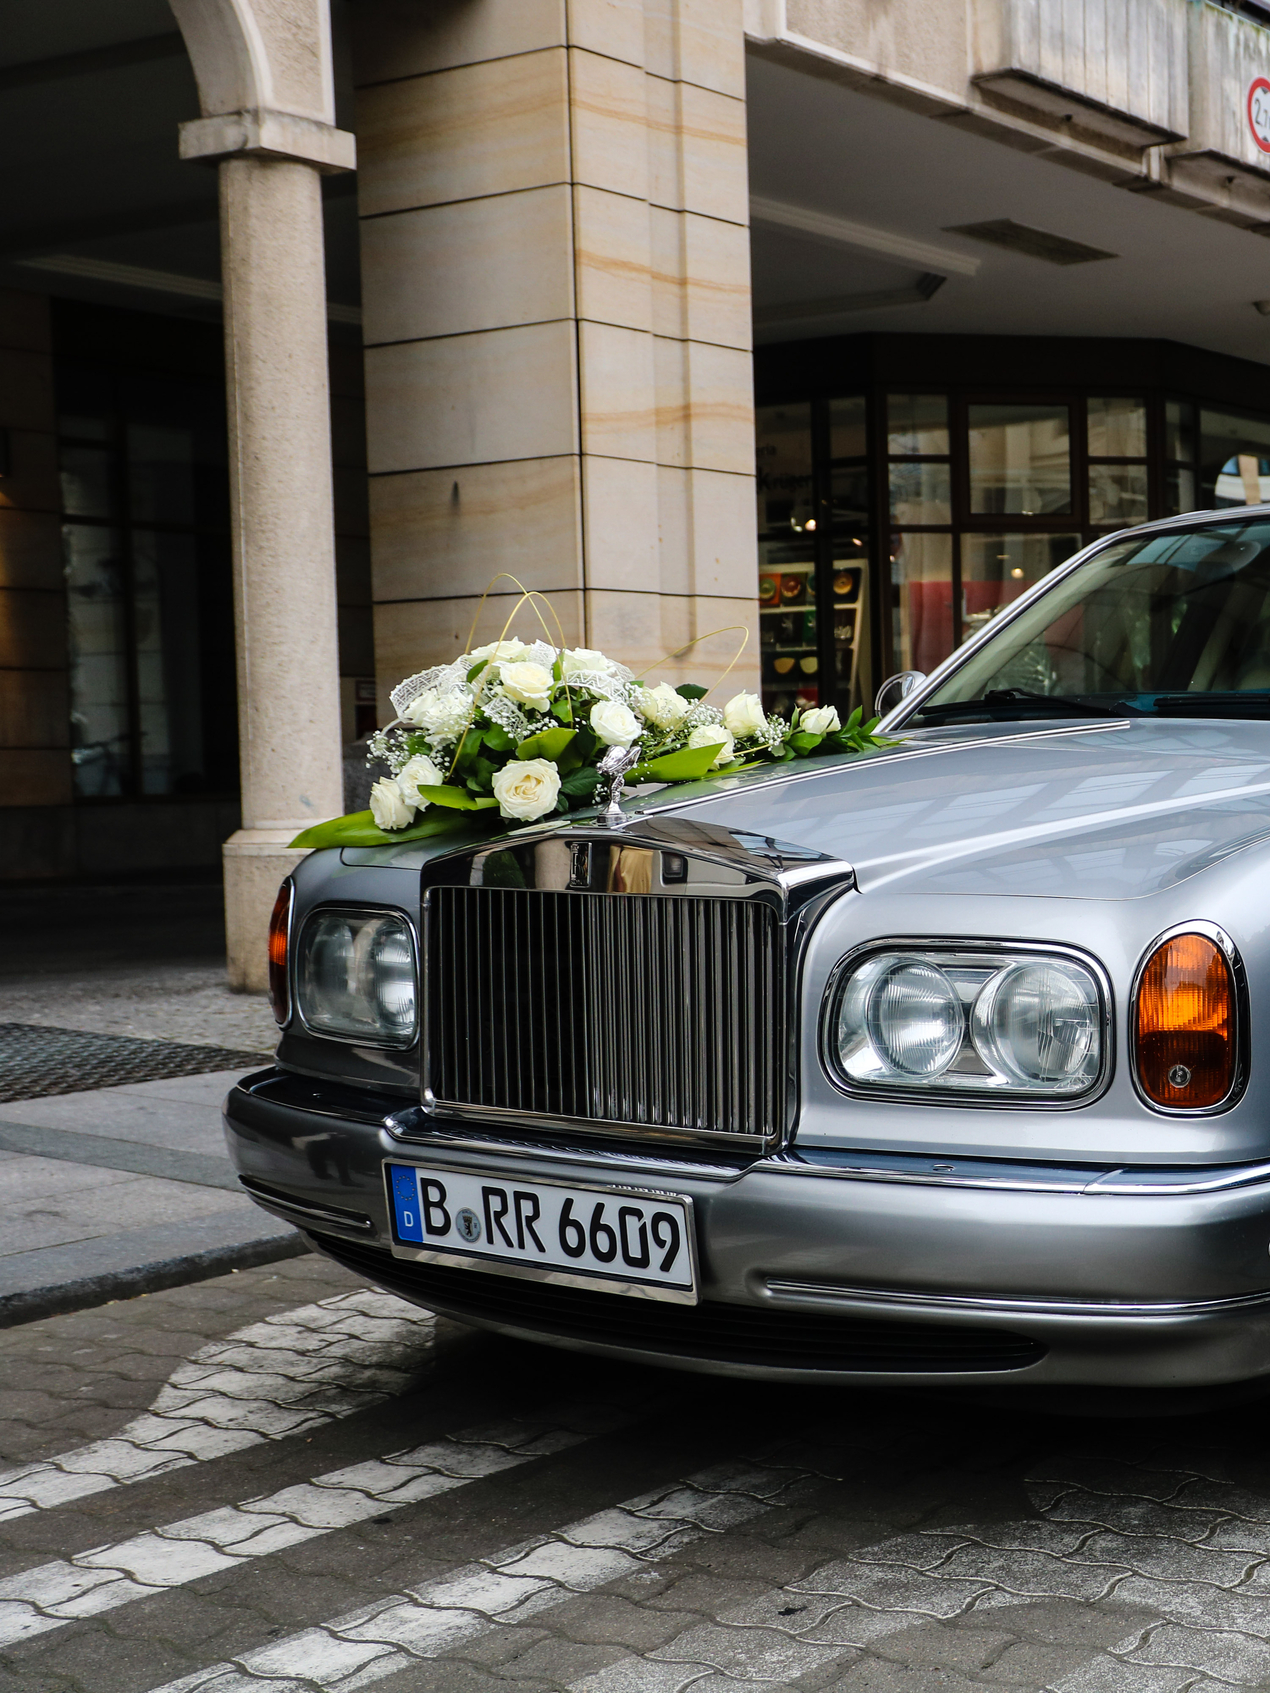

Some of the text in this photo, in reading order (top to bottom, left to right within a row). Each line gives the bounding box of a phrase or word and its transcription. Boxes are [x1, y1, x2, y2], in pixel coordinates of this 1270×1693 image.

[403, 1210, 414, 1227] D
[420, 1177, 451, 1236] B
[482, 1186, 546, 1253] RR
[558, 1198, 680, 1272] 6609
